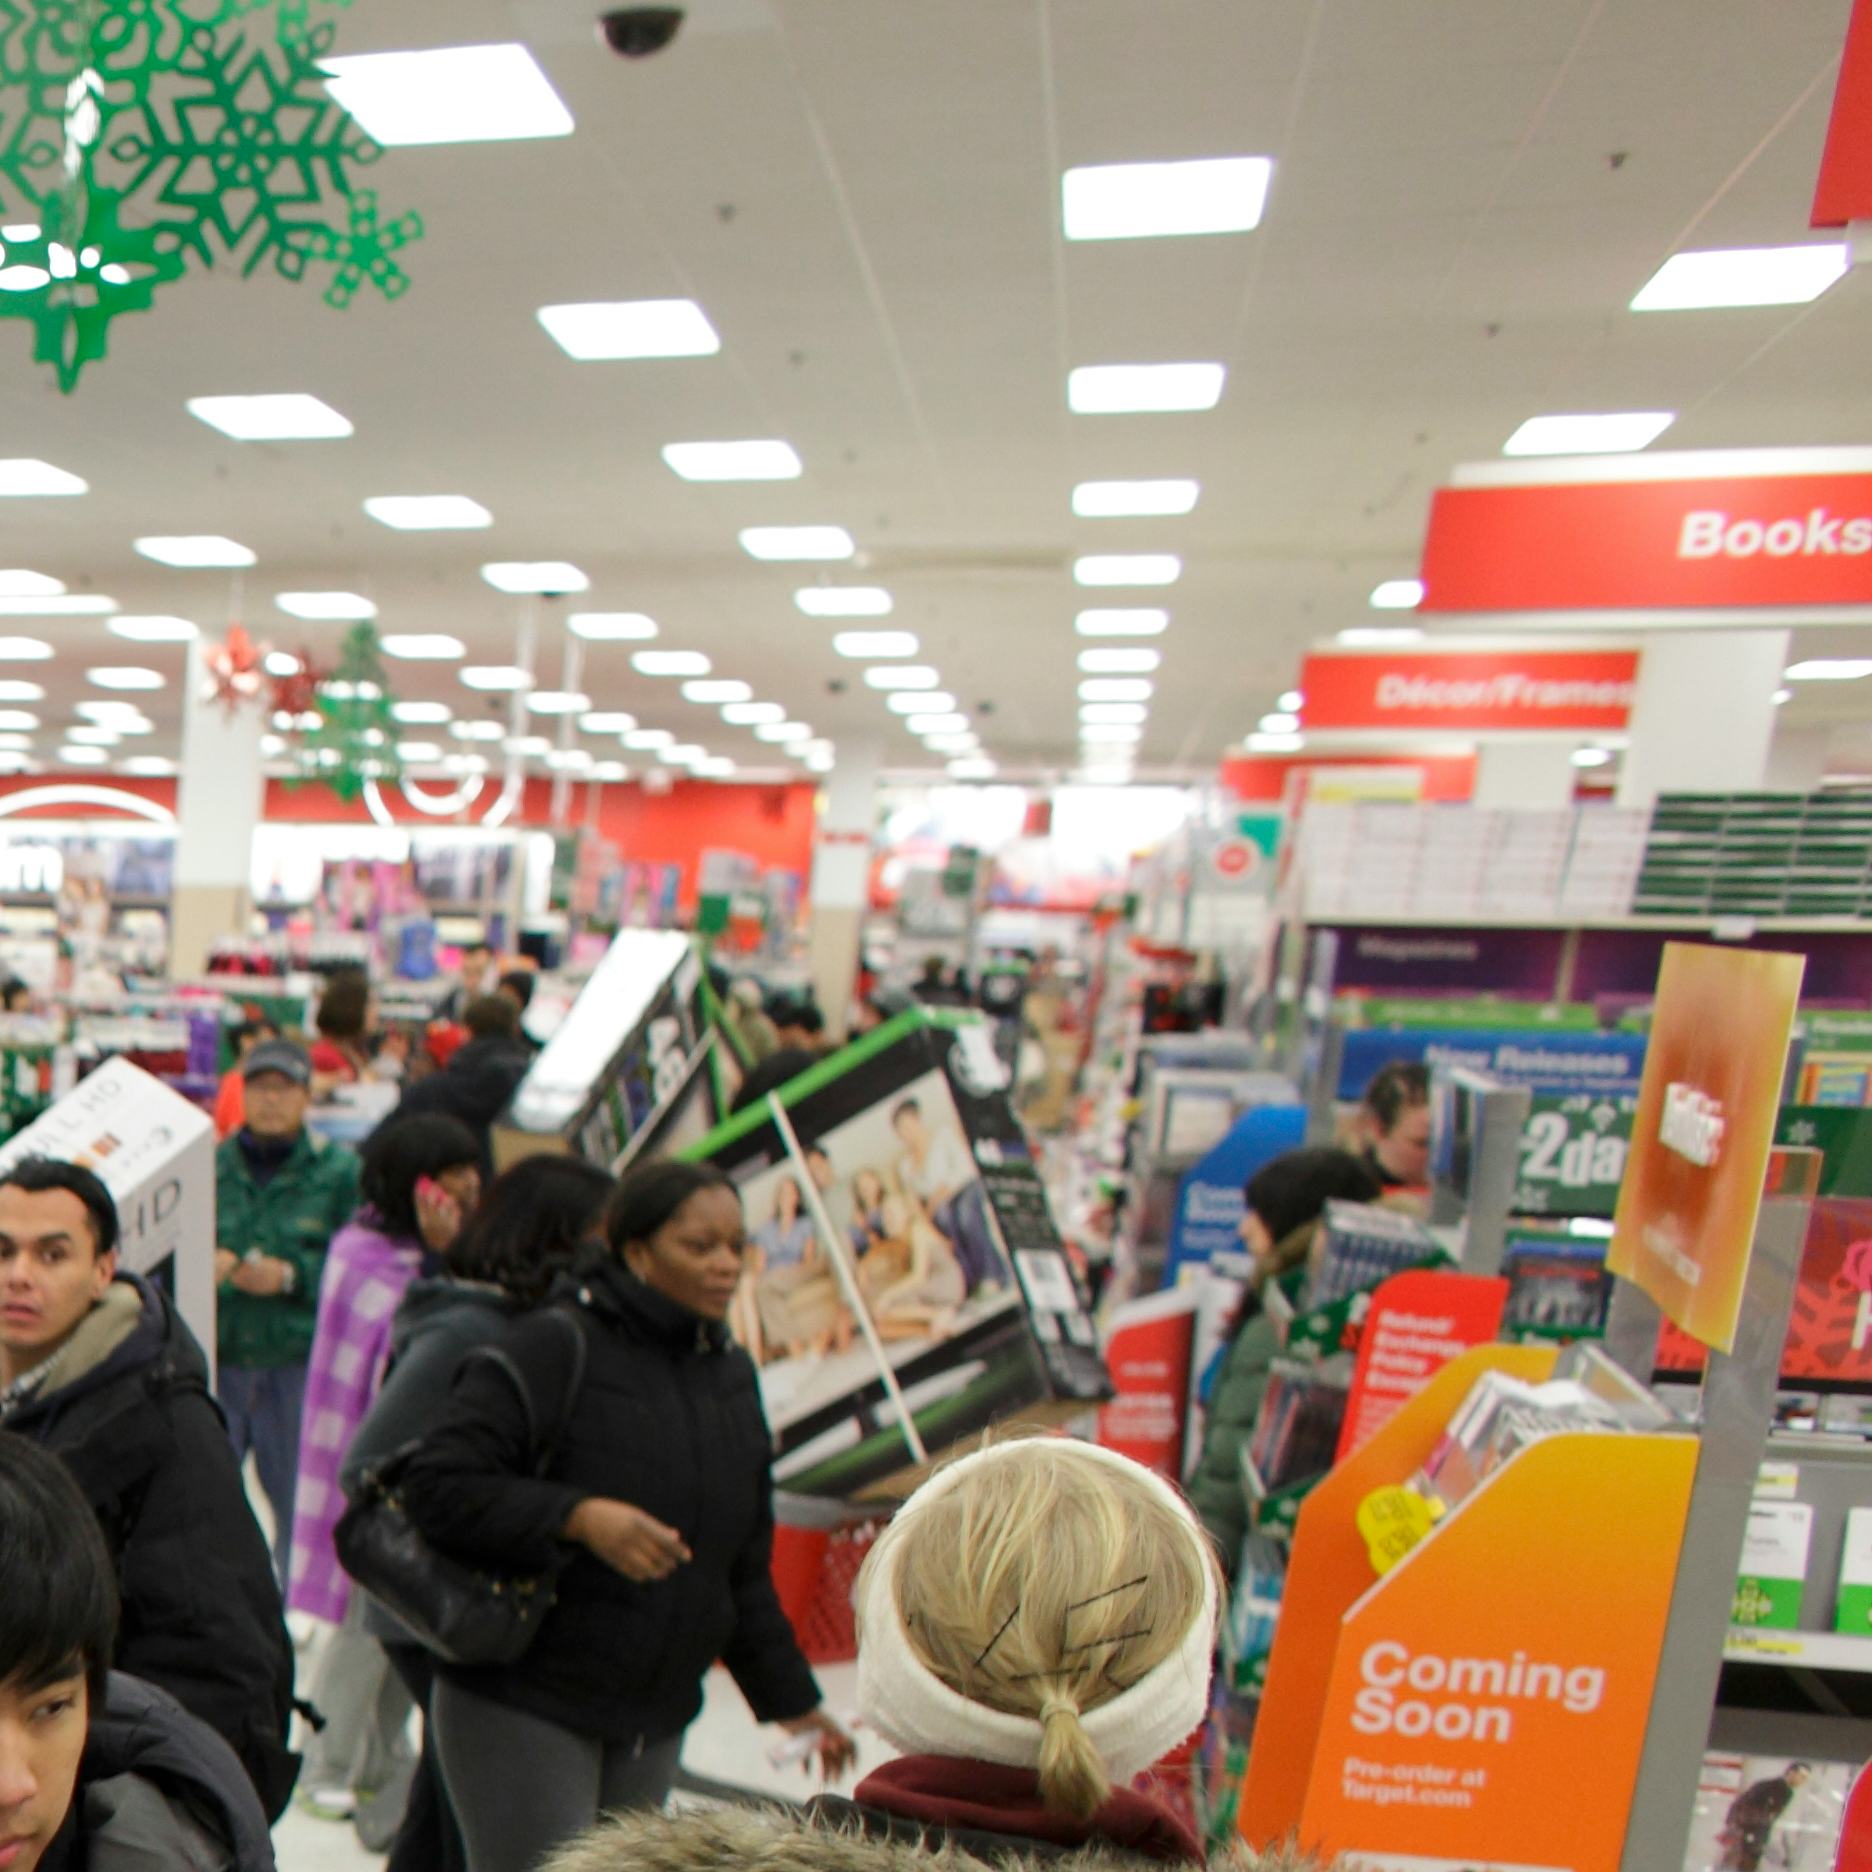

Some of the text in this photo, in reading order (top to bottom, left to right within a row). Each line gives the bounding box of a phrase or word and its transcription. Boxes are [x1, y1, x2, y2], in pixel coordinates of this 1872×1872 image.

[1676, 508, 1872, 560] Books
[1359, 1640, 1607, 1715] Coming
[1349, 1686, 1513, 1744] Soon
[1341, 1777, 1473, 1809] Target.com
[1343, 1755, 1487, 1789] Pre-order at
